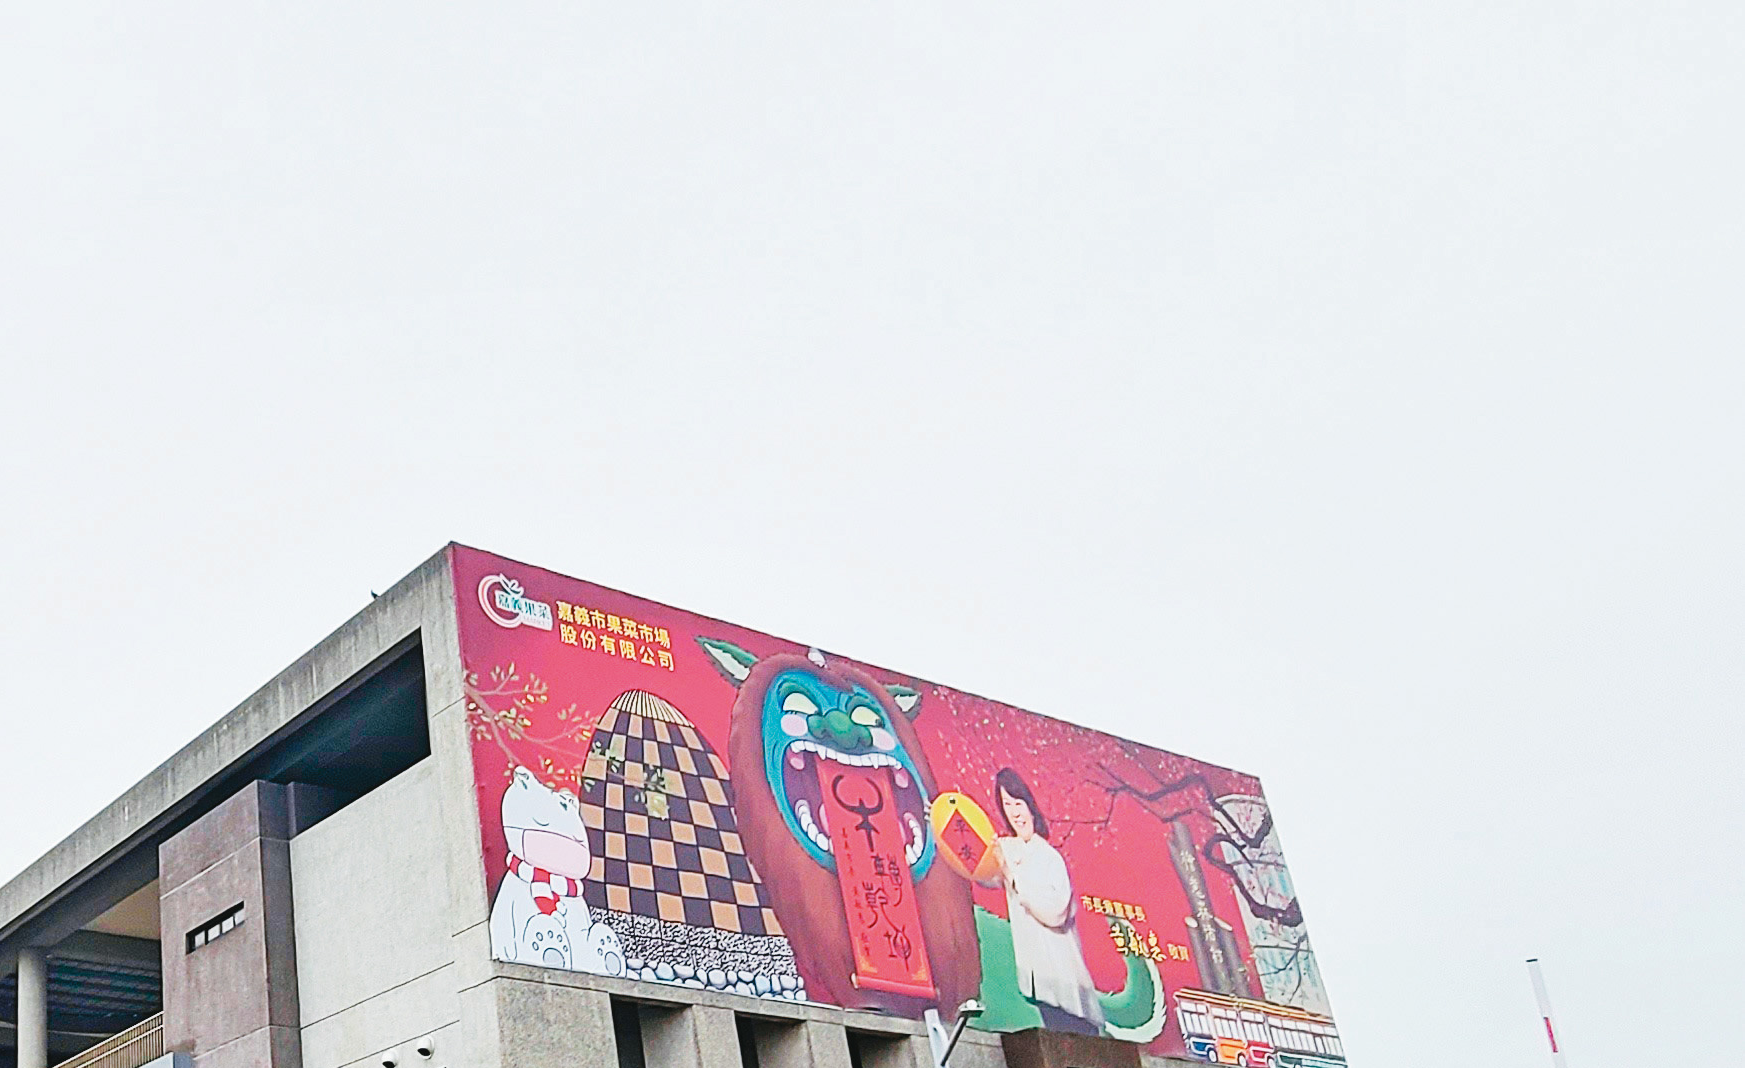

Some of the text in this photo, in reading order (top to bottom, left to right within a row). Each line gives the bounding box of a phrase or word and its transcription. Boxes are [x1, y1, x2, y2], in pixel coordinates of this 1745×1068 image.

[556, 600, 670, 648] 嘉義市果菜市場
[559, 623, 674, 672] 股份有限公司
